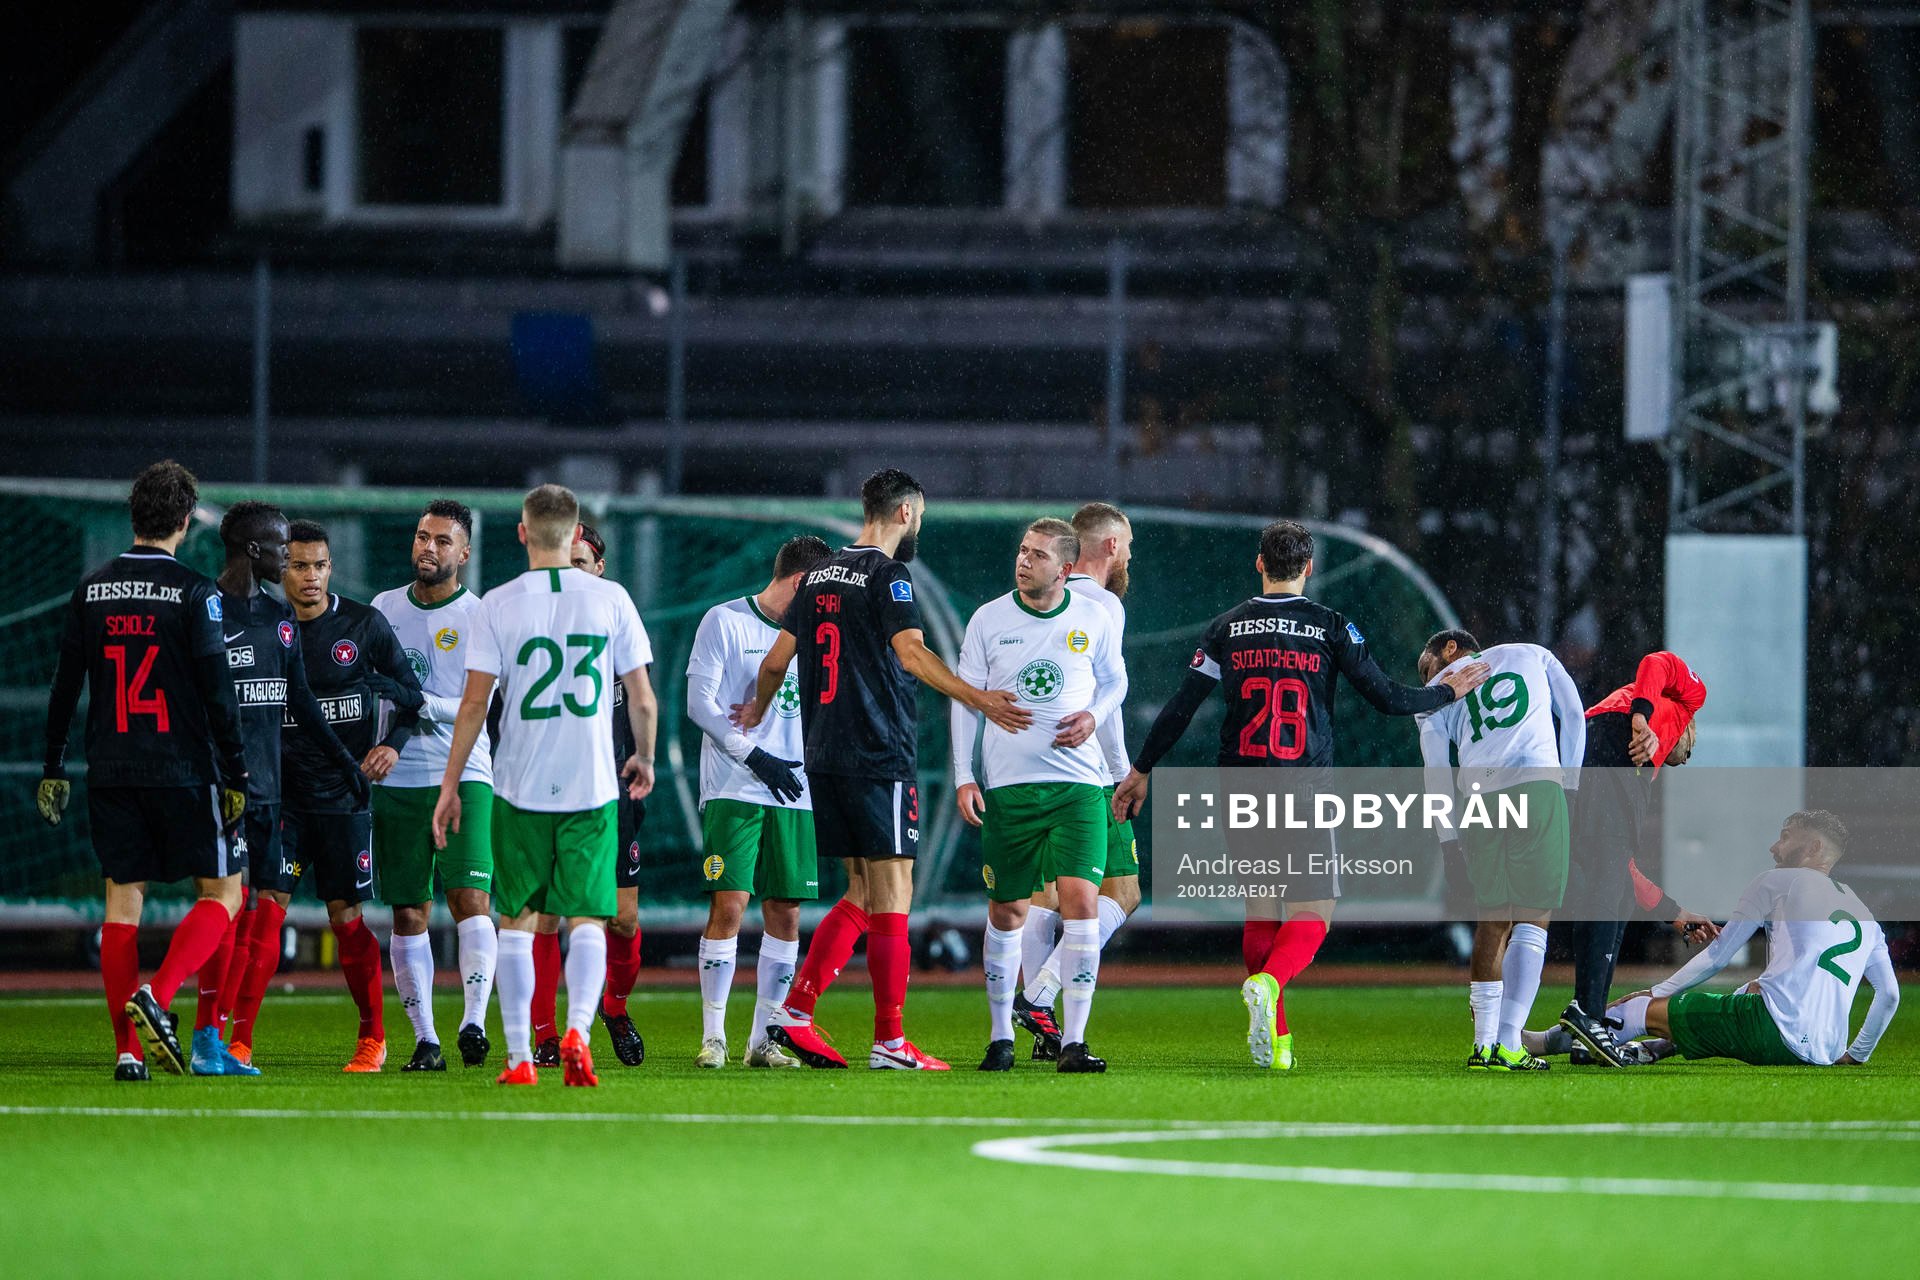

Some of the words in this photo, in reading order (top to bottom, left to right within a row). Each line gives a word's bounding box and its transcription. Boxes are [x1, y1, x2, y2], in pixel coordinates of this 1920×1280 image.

[85, 580, 183, 604] HESSEL.DK
[105, 615, 156, 636] SCHOLZ
[228, 649, 254, 667] bs
[815, 621, 841, 705] 3
[1229, 617, 1327, 642] HESSEL.DK
[103, 645, 170, 733] 14
[338, 698, 360, 719] HUS
[516, 633, 609, 722] 23
[1464, 671, 1530, 744] 19
[1238, 677, 1310, 761] 28
[1816, 909, 1863, 987] 2
